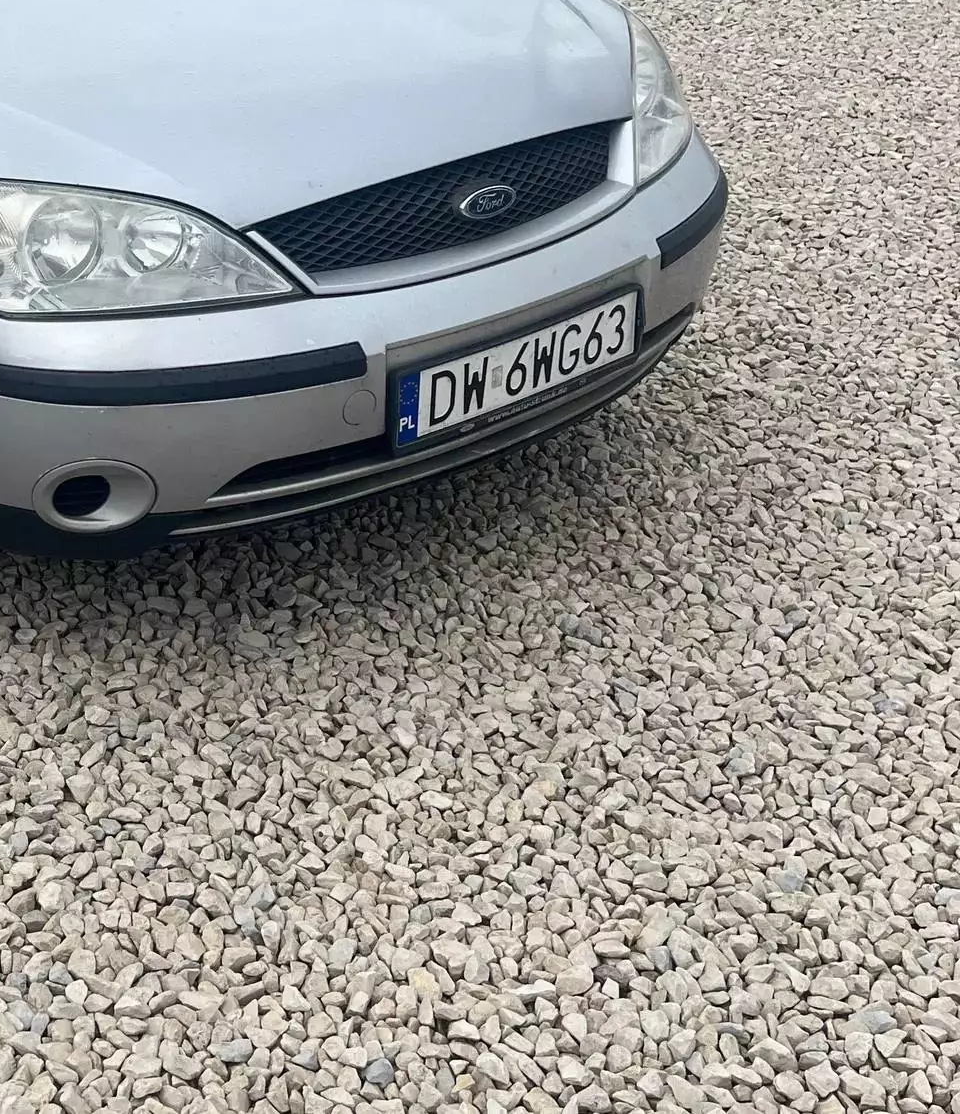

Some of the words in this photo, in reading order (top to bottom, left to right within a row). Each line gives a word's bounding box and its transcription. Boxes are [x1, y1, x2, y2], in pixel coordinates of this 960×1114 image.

[476, 193, 506, 213] Ford
[429, 356, 489, 427] DW
[505, 304, 626, 397] 6WG63
[399, 417, 415, 433] PL
